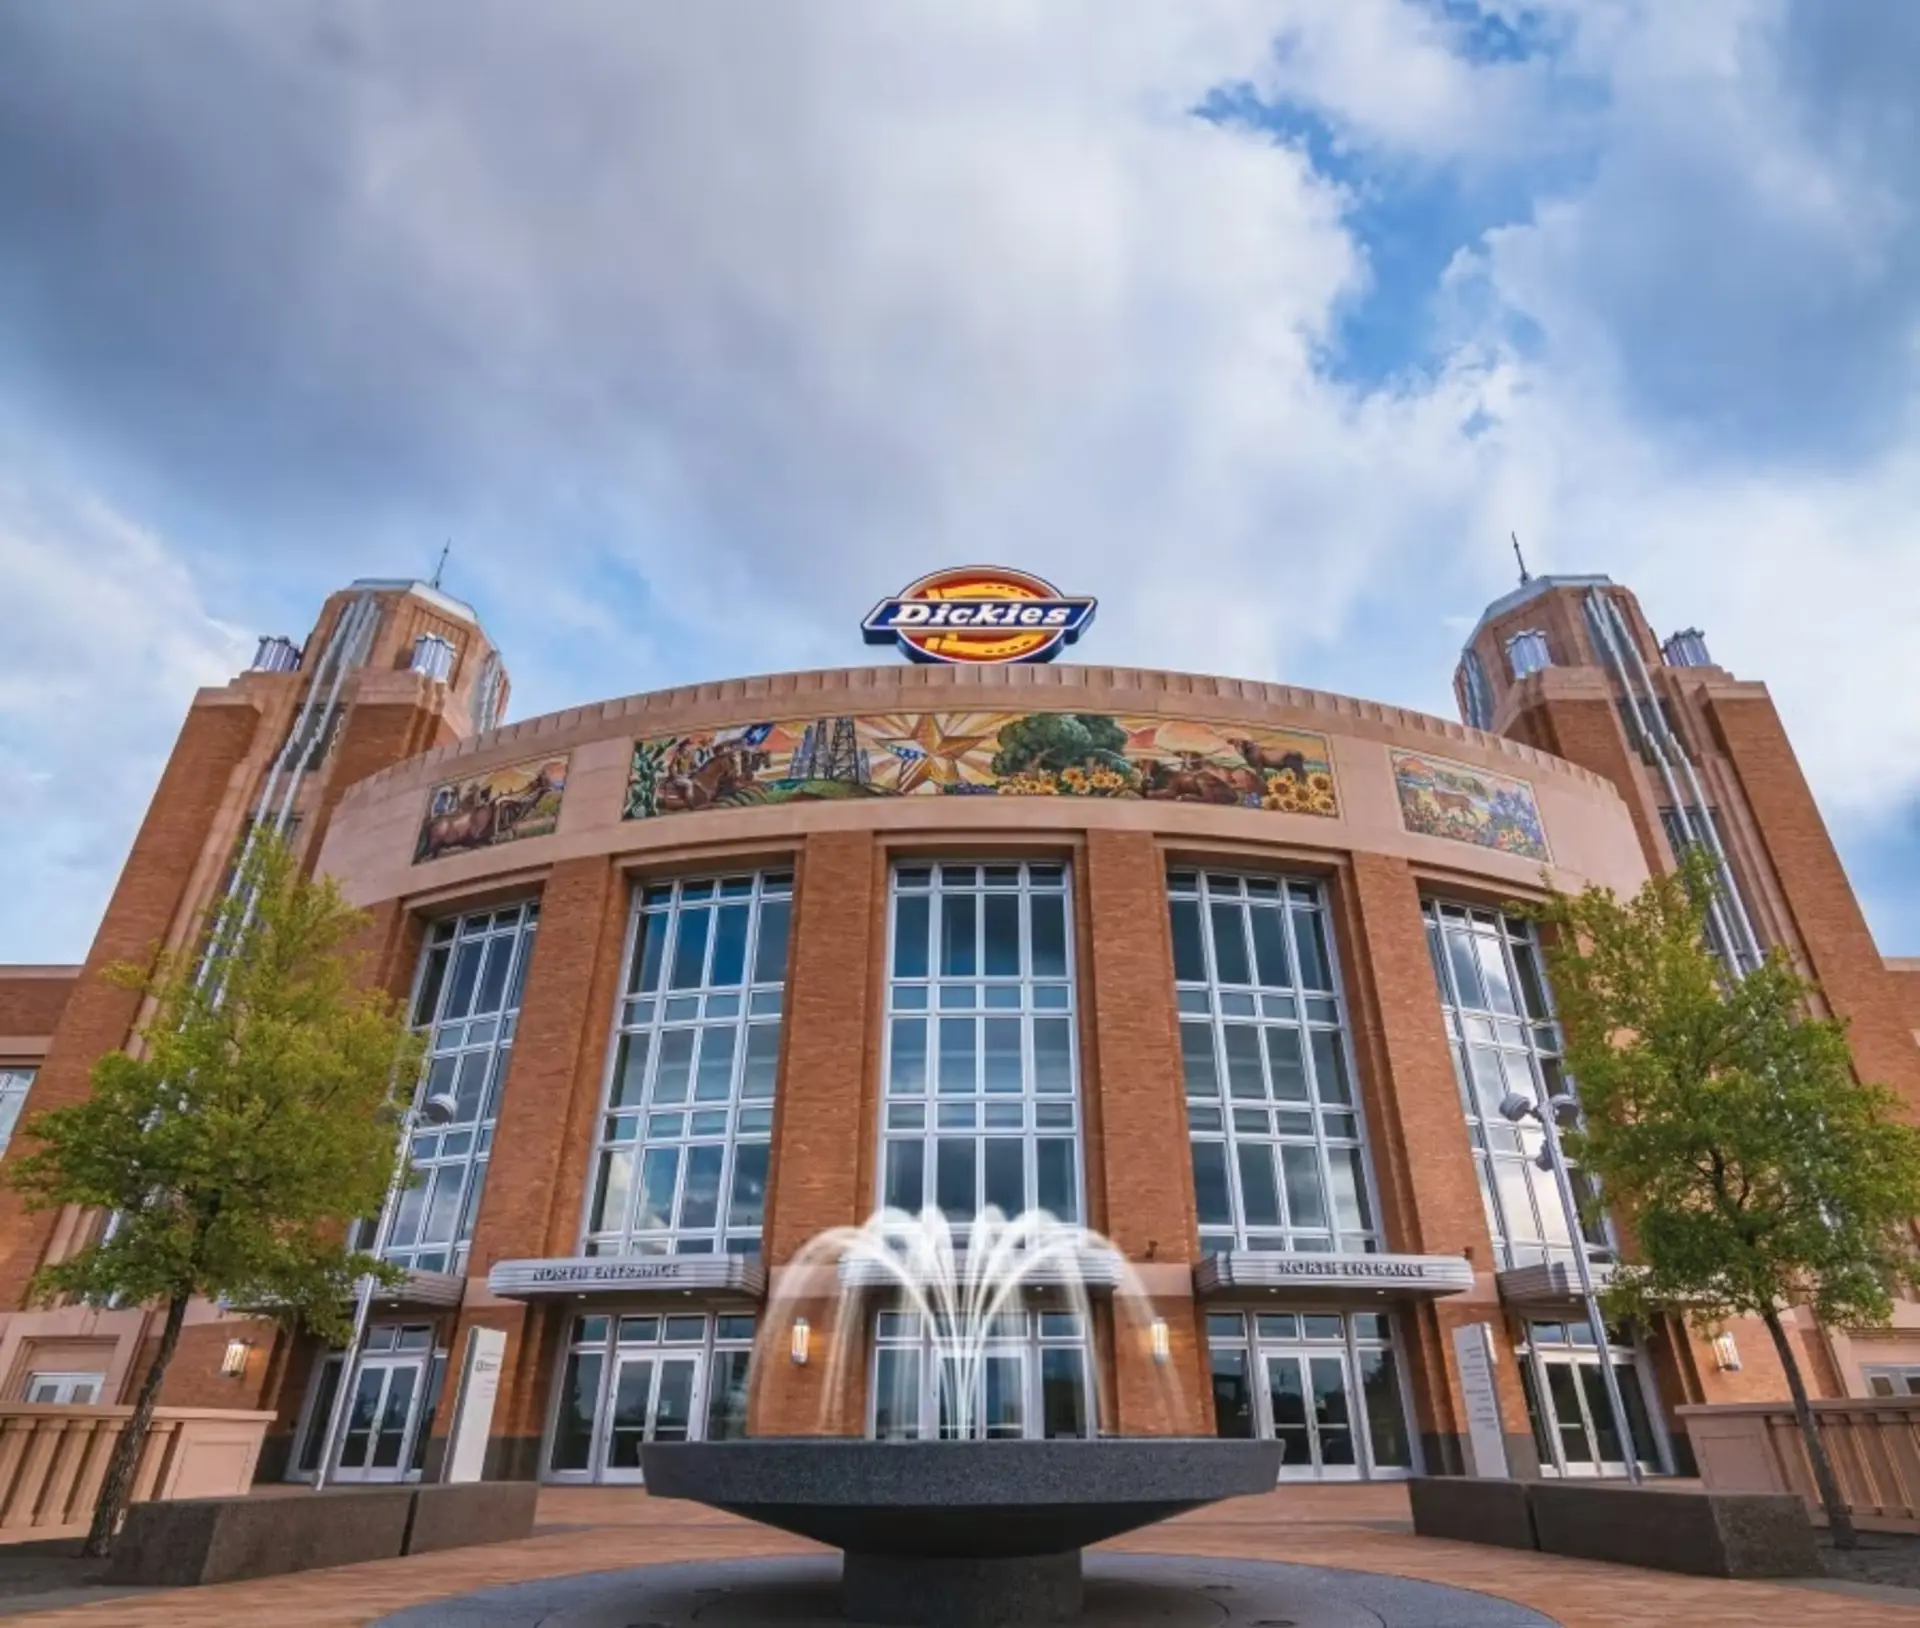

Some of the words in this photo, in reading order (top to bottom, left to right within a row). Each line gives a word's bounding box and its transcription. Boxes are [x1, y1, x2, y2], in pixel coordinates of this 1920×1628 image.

[888, 604, 1070, 625] Dickies
[532, 1266, 588, 1281] NORTH
[595, 1263, 680, 1280] ENTRANCE
[1279, 1260, 1337, 1275] NORTH
[1343, 1261, 1424, 1277] ENTRANCE
